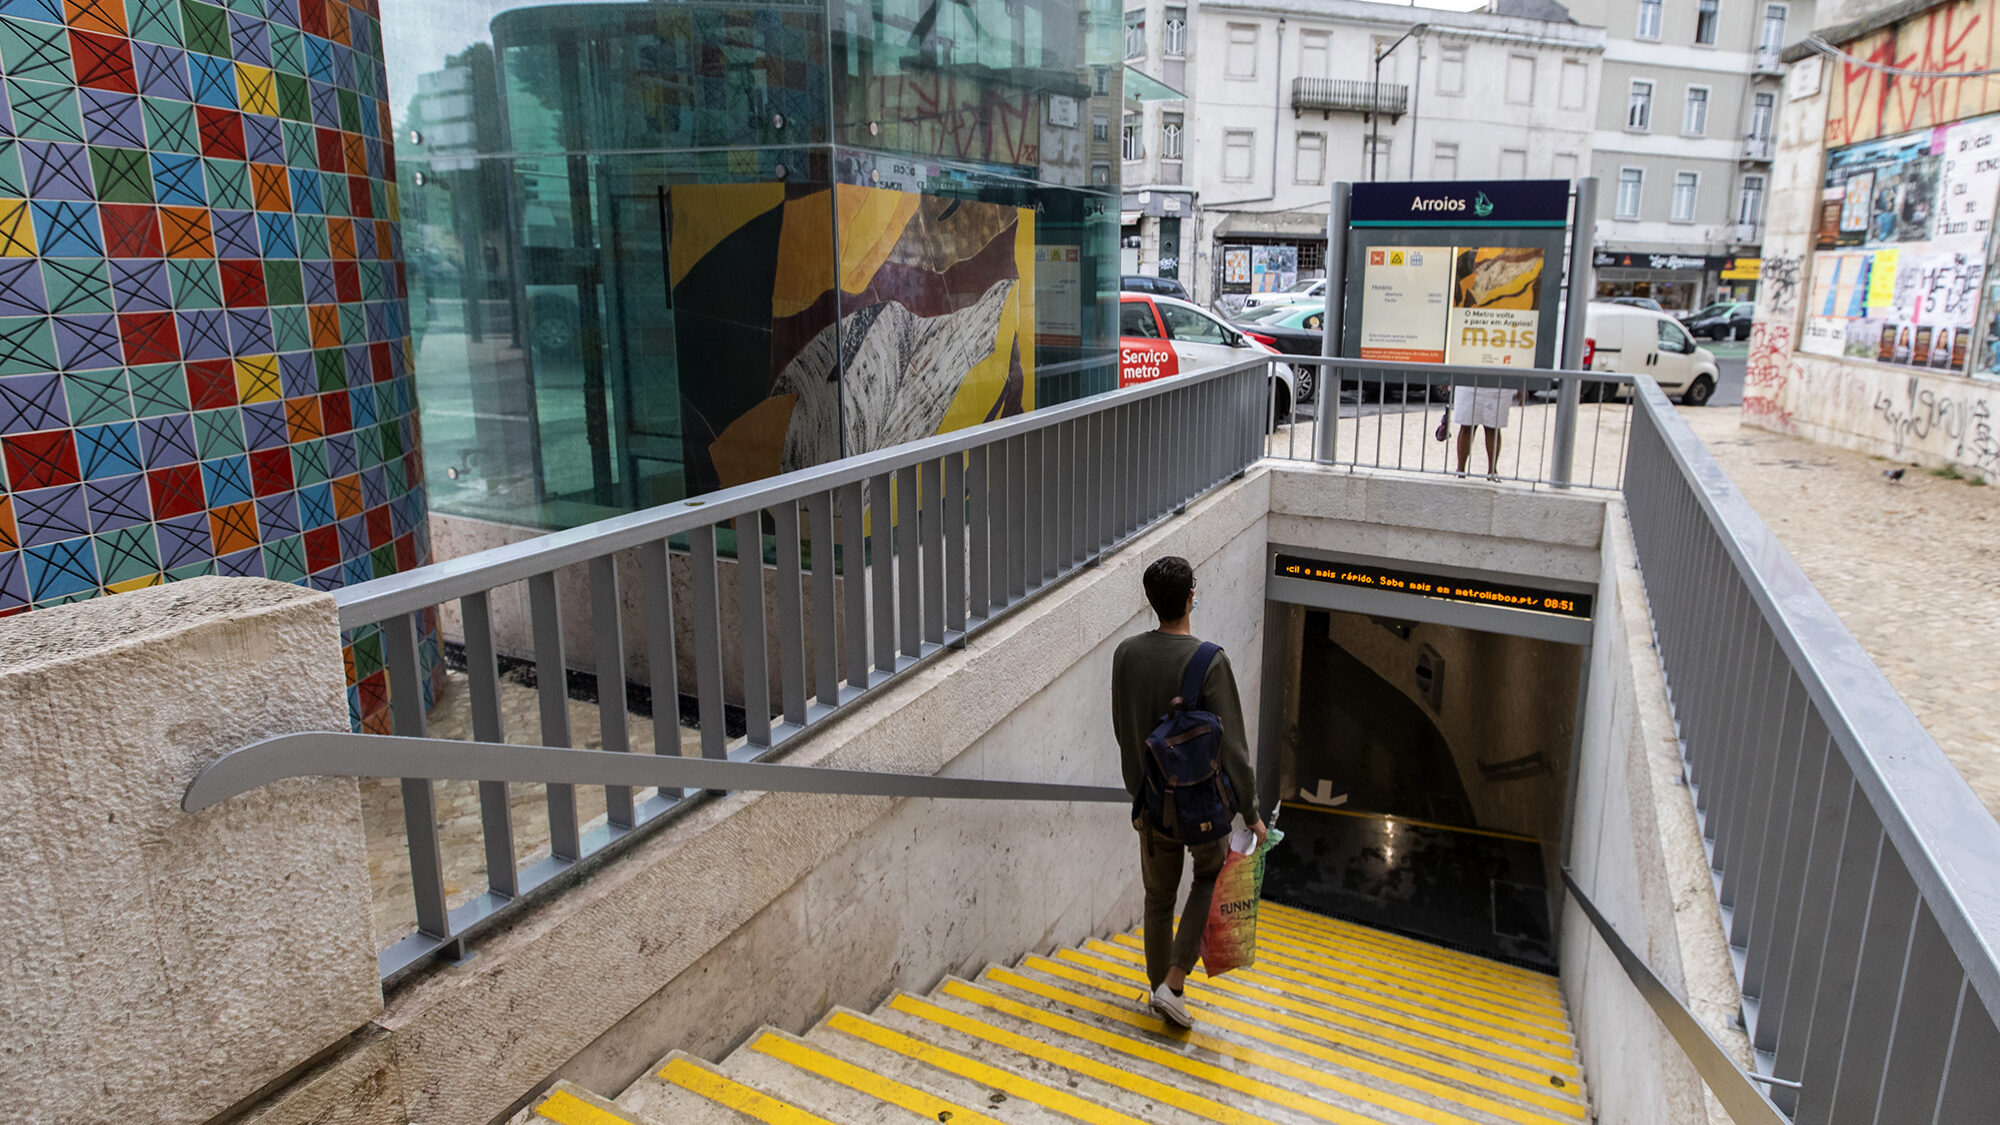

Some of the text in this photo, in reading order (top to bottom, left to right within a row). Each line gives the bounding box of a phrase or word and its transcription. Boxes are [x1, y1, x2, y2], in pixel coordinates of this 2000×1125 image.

[1411, 196, 1466, 211] Arroios
[1461, 323, 1535, 349] mais
[1122, 348, 1169, 366] Serviço
[1124, 365, 1160, 379] metro
[1315, 570, 1336, 579] mais
[1341, 572, 1374, 584] rápido.
[1409, 582, 1432, 592] mais
[1436, 585, 1450, 594] em
[1455, 588, 1539, 605] metrolisboa.pt/
[1544, 597, 1574, 611] 08:51
